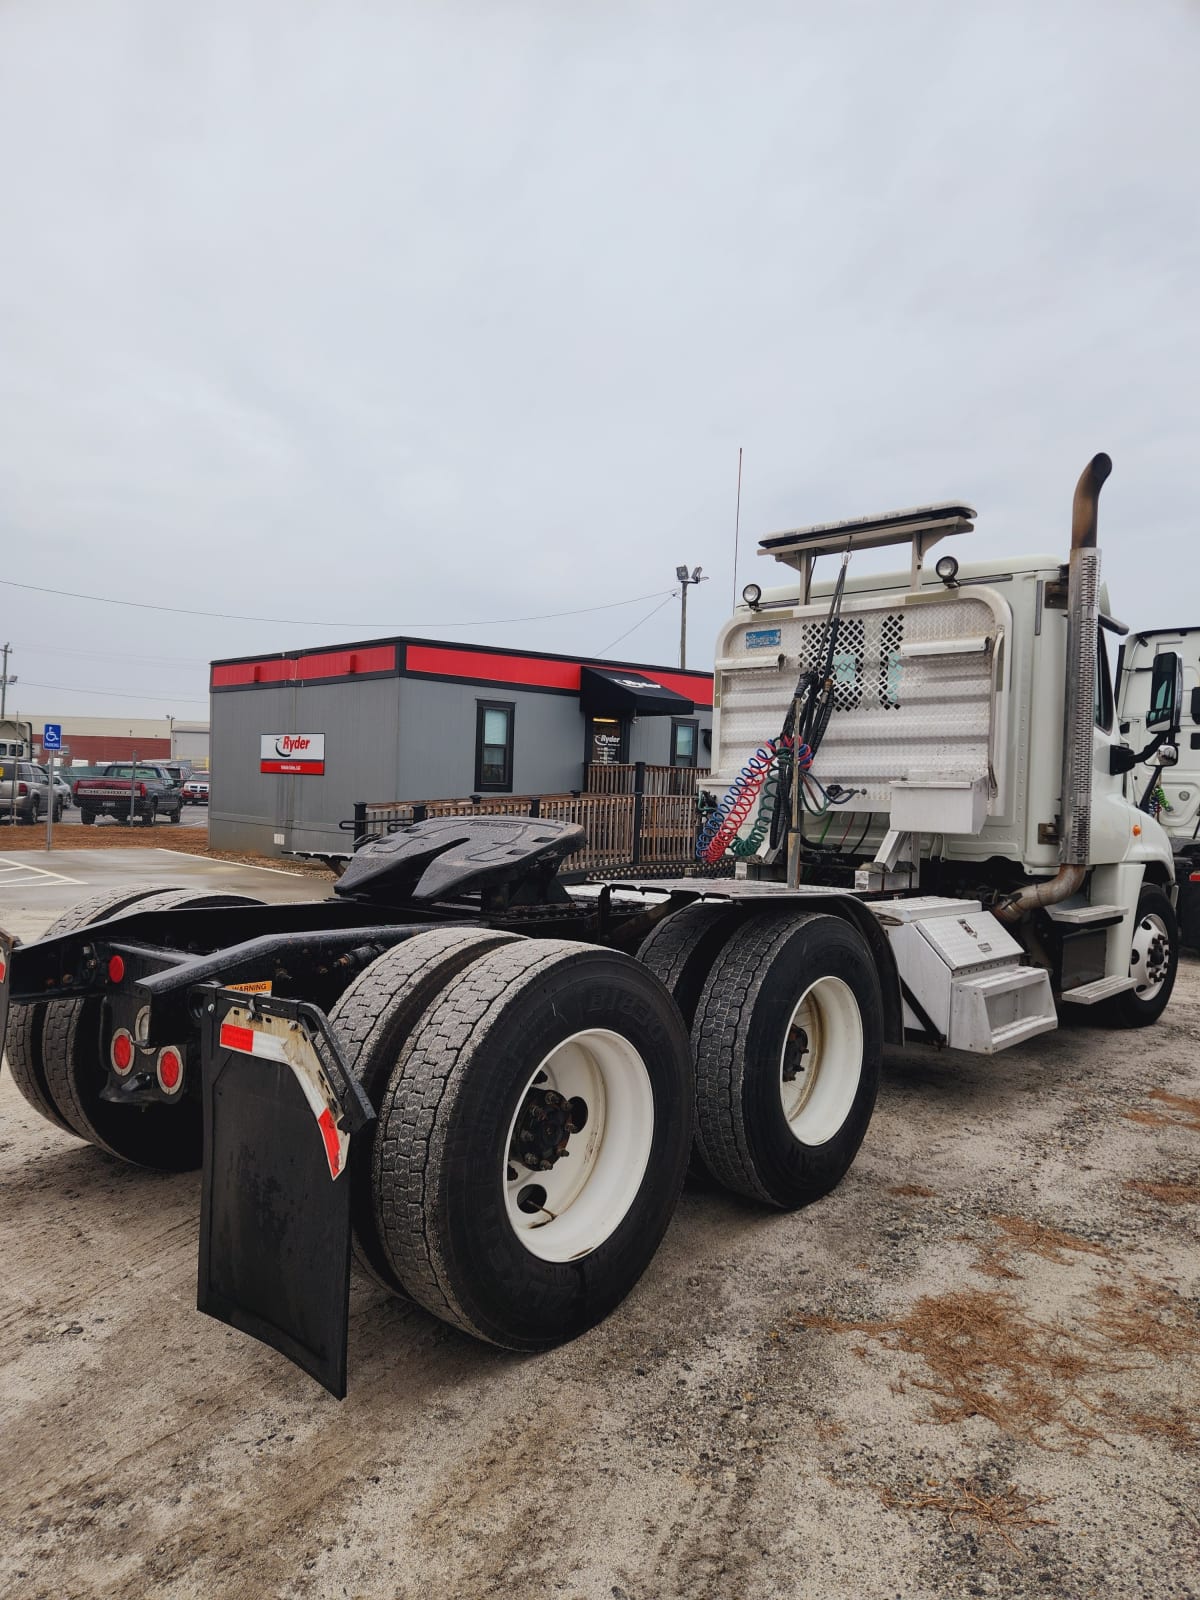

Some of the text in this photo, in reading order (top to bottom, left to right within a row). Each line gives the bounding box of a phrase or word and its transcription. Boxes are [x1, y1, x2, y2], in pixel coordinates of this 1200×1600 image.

[282, 735, 311, 753] Ryder
[600, 734, 621, 744] Ryder
[231, 983, 267, 992] WARNING
